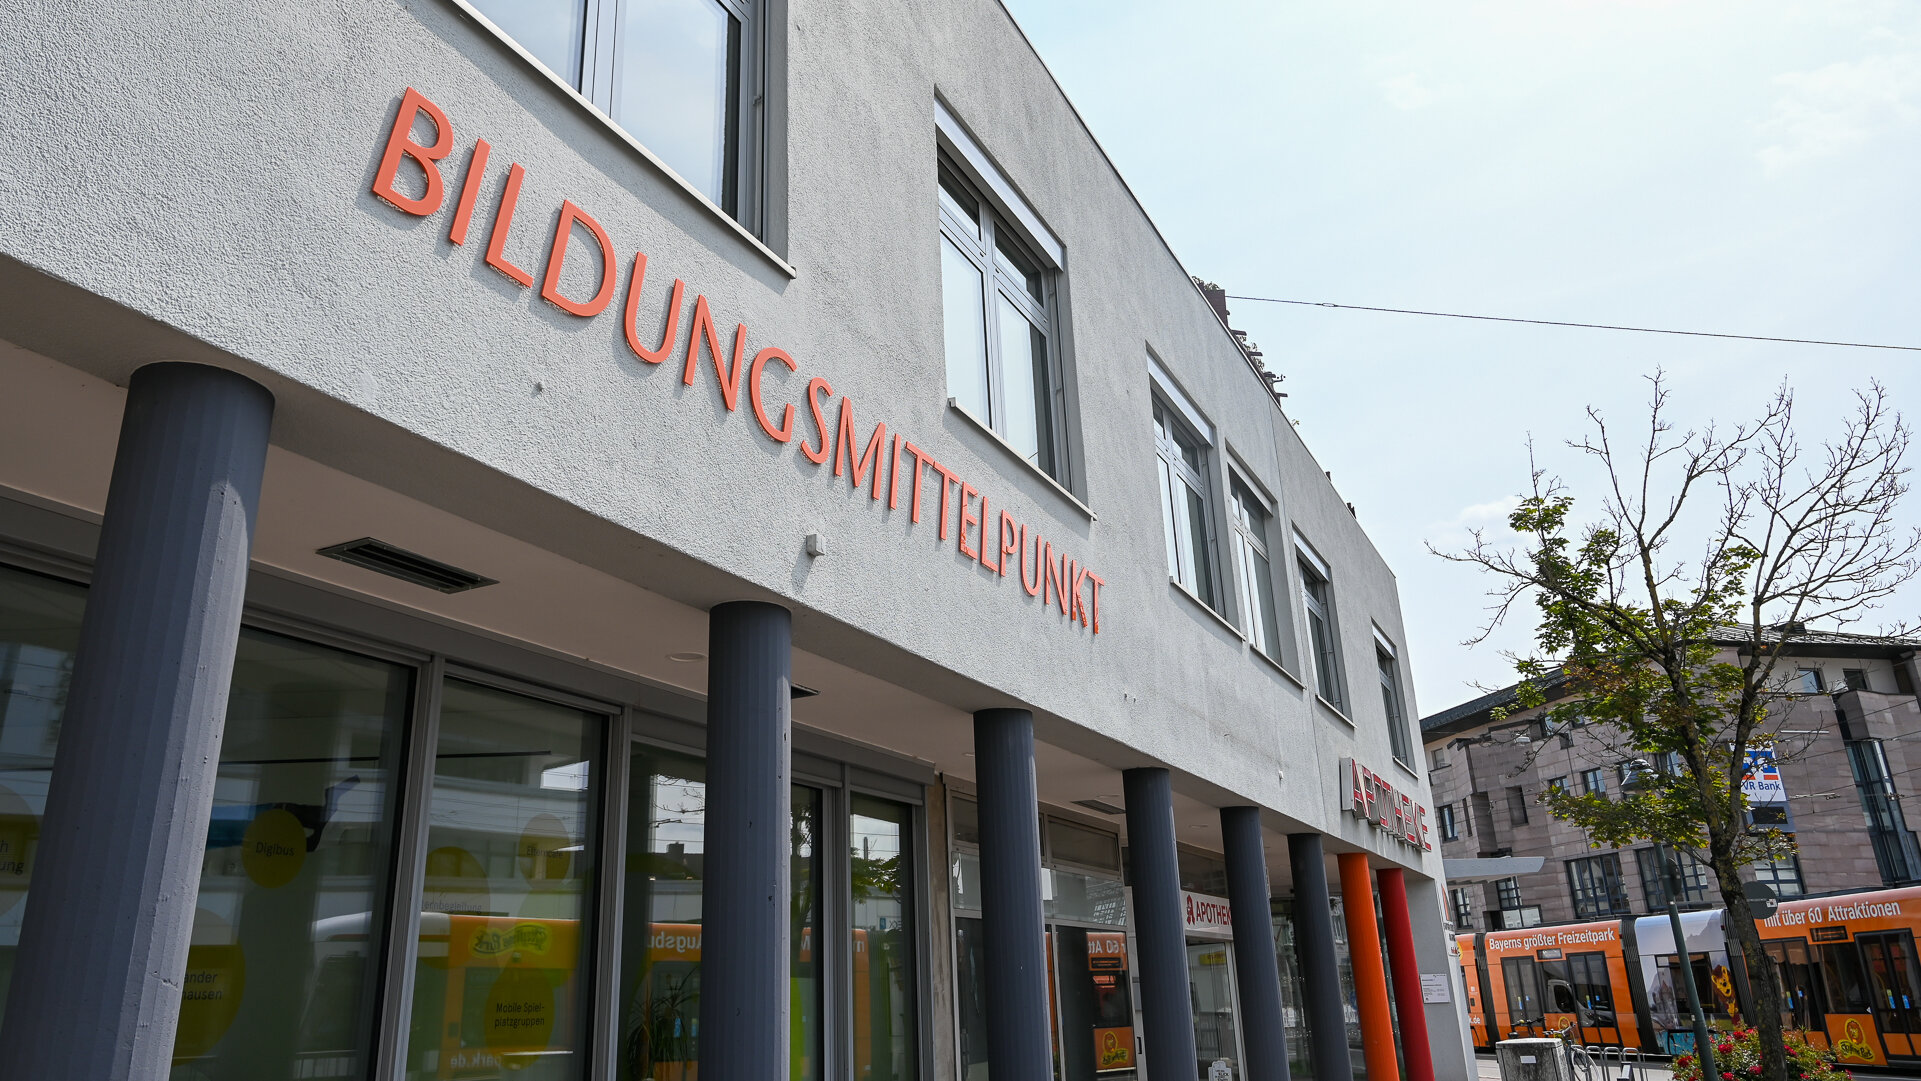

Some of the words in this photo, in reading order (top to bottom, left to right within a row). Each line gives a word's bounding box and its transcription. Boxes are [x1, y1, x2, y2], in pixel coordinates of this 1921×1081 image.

[373, 86, 1105, 635] BILDUNGSMITTELPUNKT
[1742, 781, 1756, 791] VR
[1758, 781, 1781, 791] Bank
[1349, 758, 1432, 852] APOTHEKE
[256, 841, 295, 857] Digibus
[1782, 910, 1806, 926] über
[1808, 906, 1823, 923] 60
[1828, 901, 1901, 922] Attraktionen
[1489, 938, 1522, 952] Bayerns
[1523, 934, 1556, 950] größter
[1557, 927, 1615, 945] Freizeitpark
[496, 1002, 522, 1013] Mobile
[523, 1002, 545, 1014] Spiel-
[494, 1016, 545, 1029] platzgruppen
